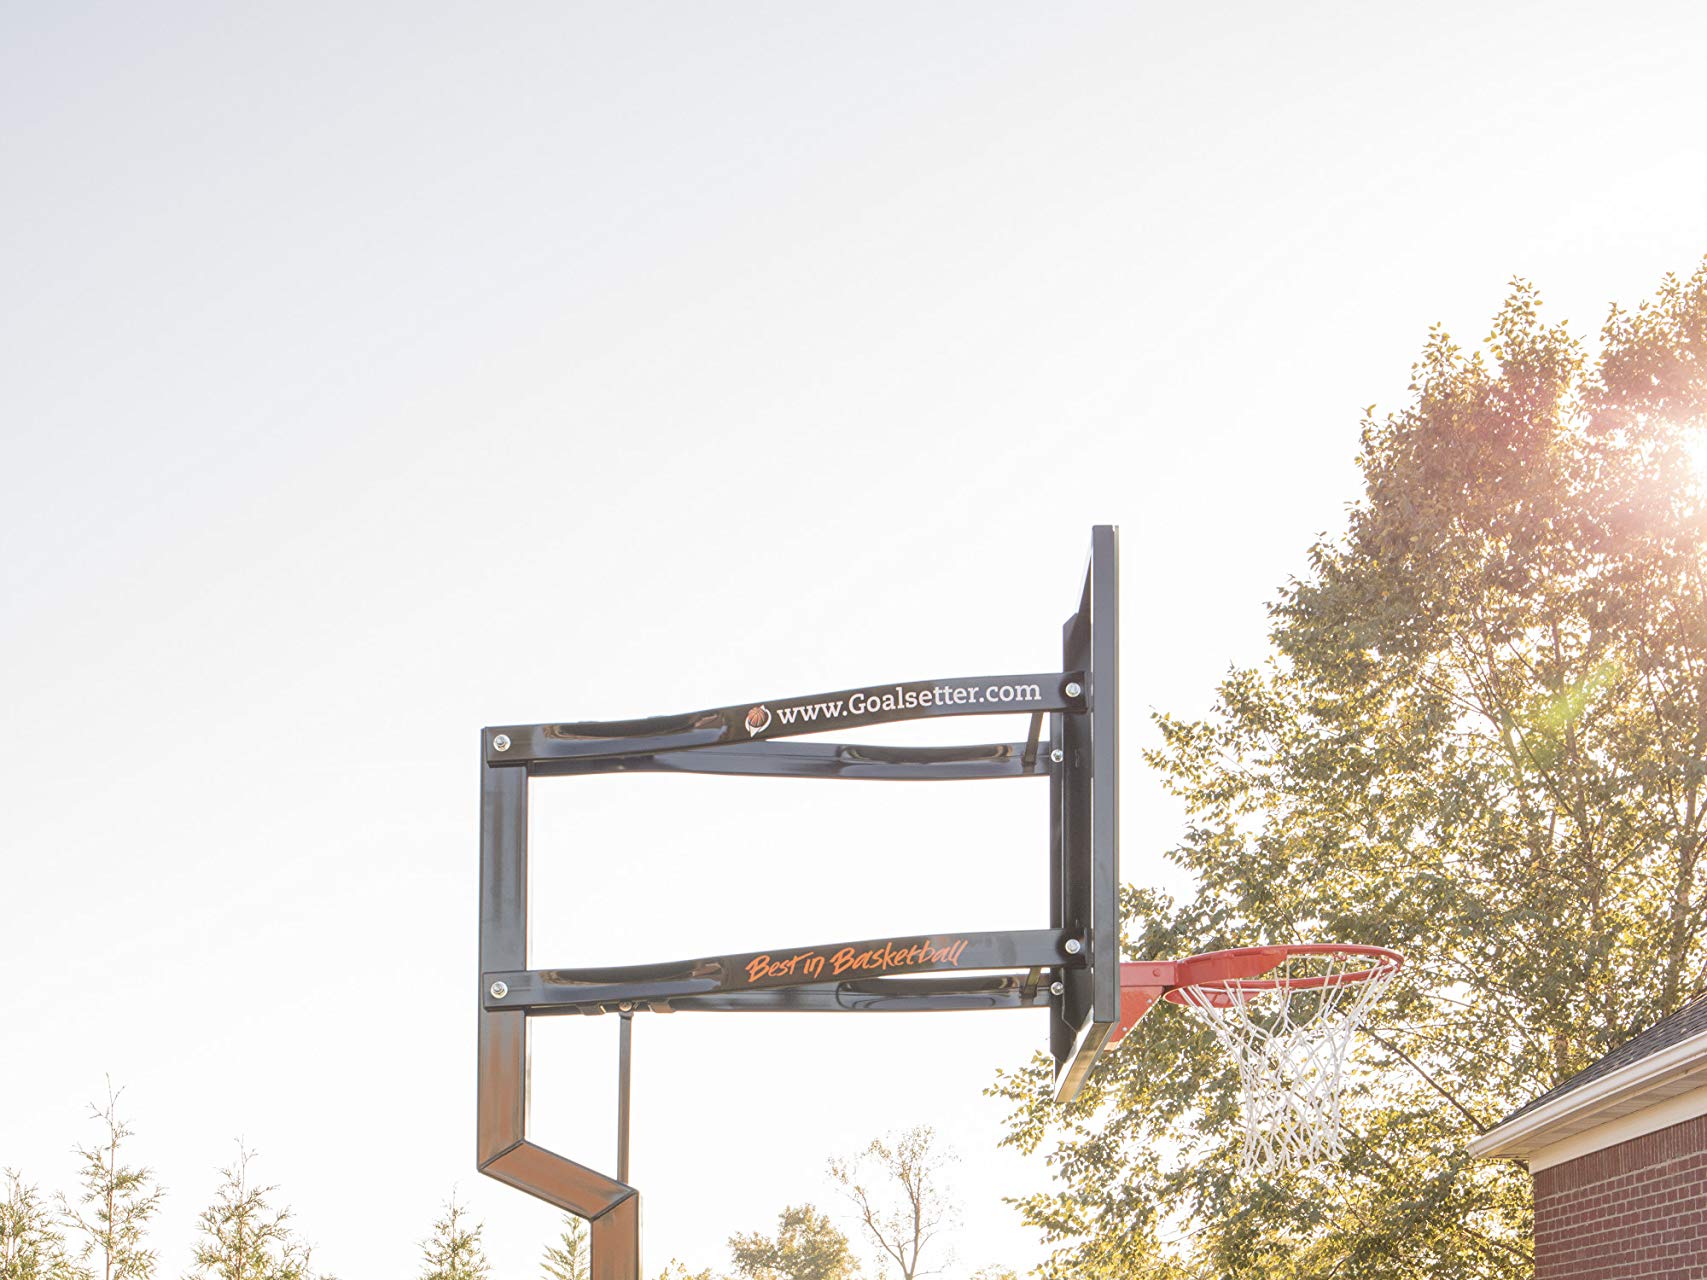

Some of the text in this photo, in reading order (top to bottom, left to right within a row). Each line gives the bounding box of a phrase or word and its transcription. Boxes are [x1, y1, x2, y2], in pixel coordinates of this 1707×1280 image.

[777, 683, 1042, 725] www.Goalsetter.com
[745, 940, 969, 983] Best in Basketball
